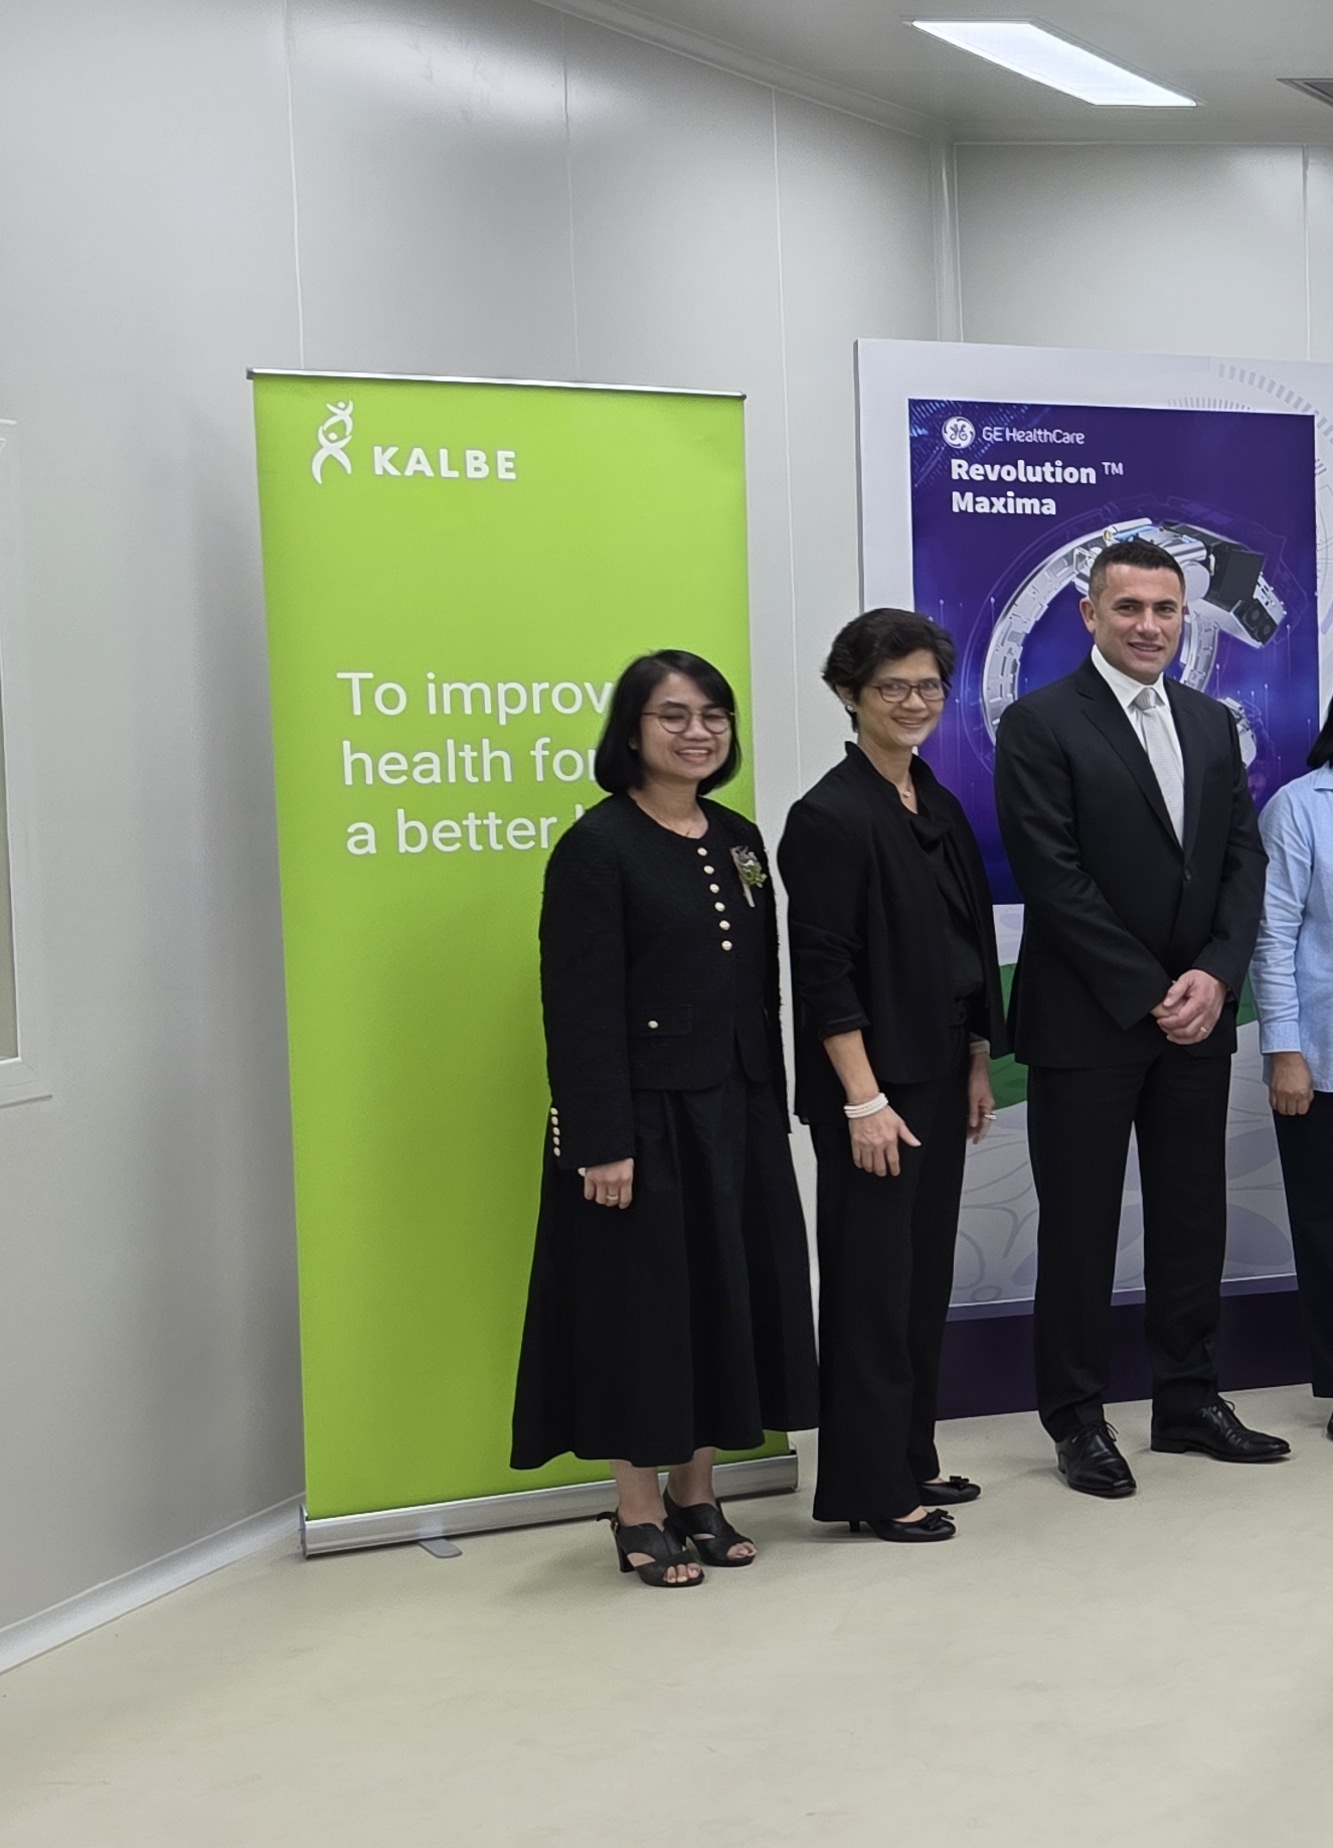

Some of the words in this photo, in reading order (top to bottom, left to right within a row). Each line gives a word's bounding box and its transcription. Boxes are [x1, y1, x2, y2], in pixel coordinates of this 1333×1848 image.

[982, 426, 1003, 441] GE
[1005, 427, 1085, 445] HealthCare
[373, 445, 517, 480] KALBE
[950, 458, 1097, 484] Revolution
[951, 490, 1057, 515] Maxima
[336, 671, 407, 716] To
[426, 671, 613, 726] improv
[342, 738, 513, 786] health
[346, 821, 377, 856] a
[396, 808, 558, 854] better
